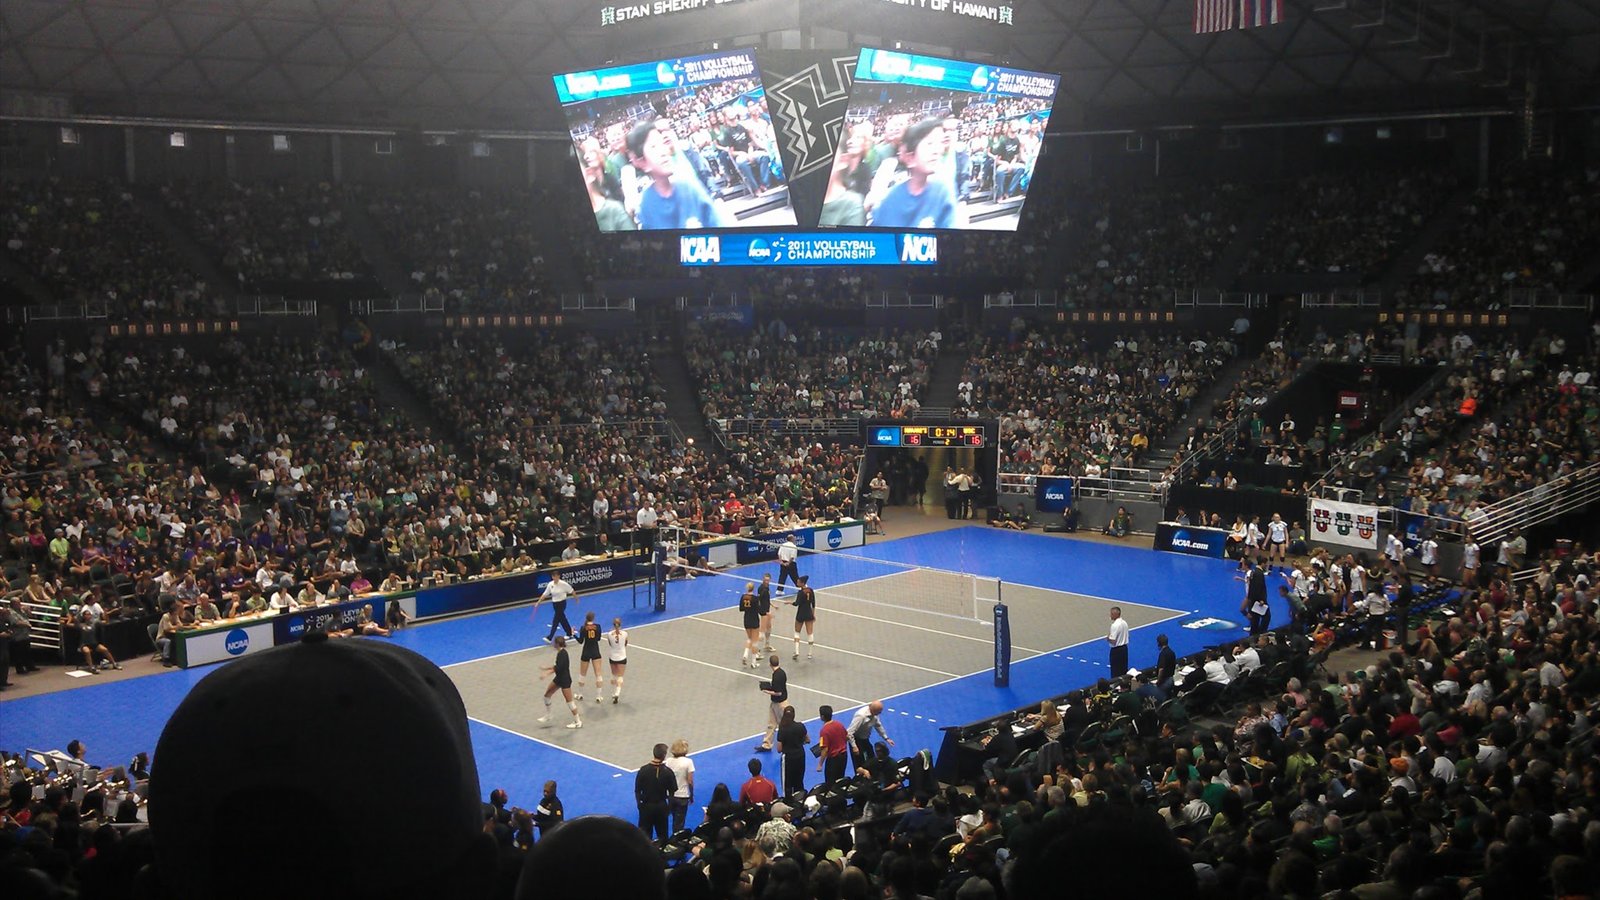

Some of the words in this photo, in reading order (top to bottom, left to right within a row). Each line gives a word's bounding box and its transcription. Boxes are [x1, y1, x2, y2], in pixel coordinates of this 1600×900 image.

[931, 0, 950, 11] OF
[616, 3, 650, 21] STAN
[684, 61, 701, 73] 2011
[703, 54, 753, 70] VOLLEYBALL
[686, 64, 754, 82] CHAMPIONSHIP
[999, 72, 1015, 84] 2011
[1015, 74, 1055, 89] VOLLEYBALL
[996, 82, 1054, 97] CHAMPIONSHIP
[787, 240, 811, 250] 2011
[813, 240, 876, 250] VOLLEYBALL
[748, 248, 770, 257] NCAA
[787, 249, 876, 260] CHAMPIONSHIP
[935, 427, 955, 437] 0:14
[971, 436, 981, 445] 16
[1172, 538, 1209, 550] NCAA.com
[561, 571, 575, 580] 2011
[575, 566, 613, 577] VOLLEYBALL
[566, 571, 613, 585] HAMPIONSHIP
[316, 614, 330, 622] 2011
[588, 630, 596, 639] 10
[227, 638, 249, 651] NCAA
